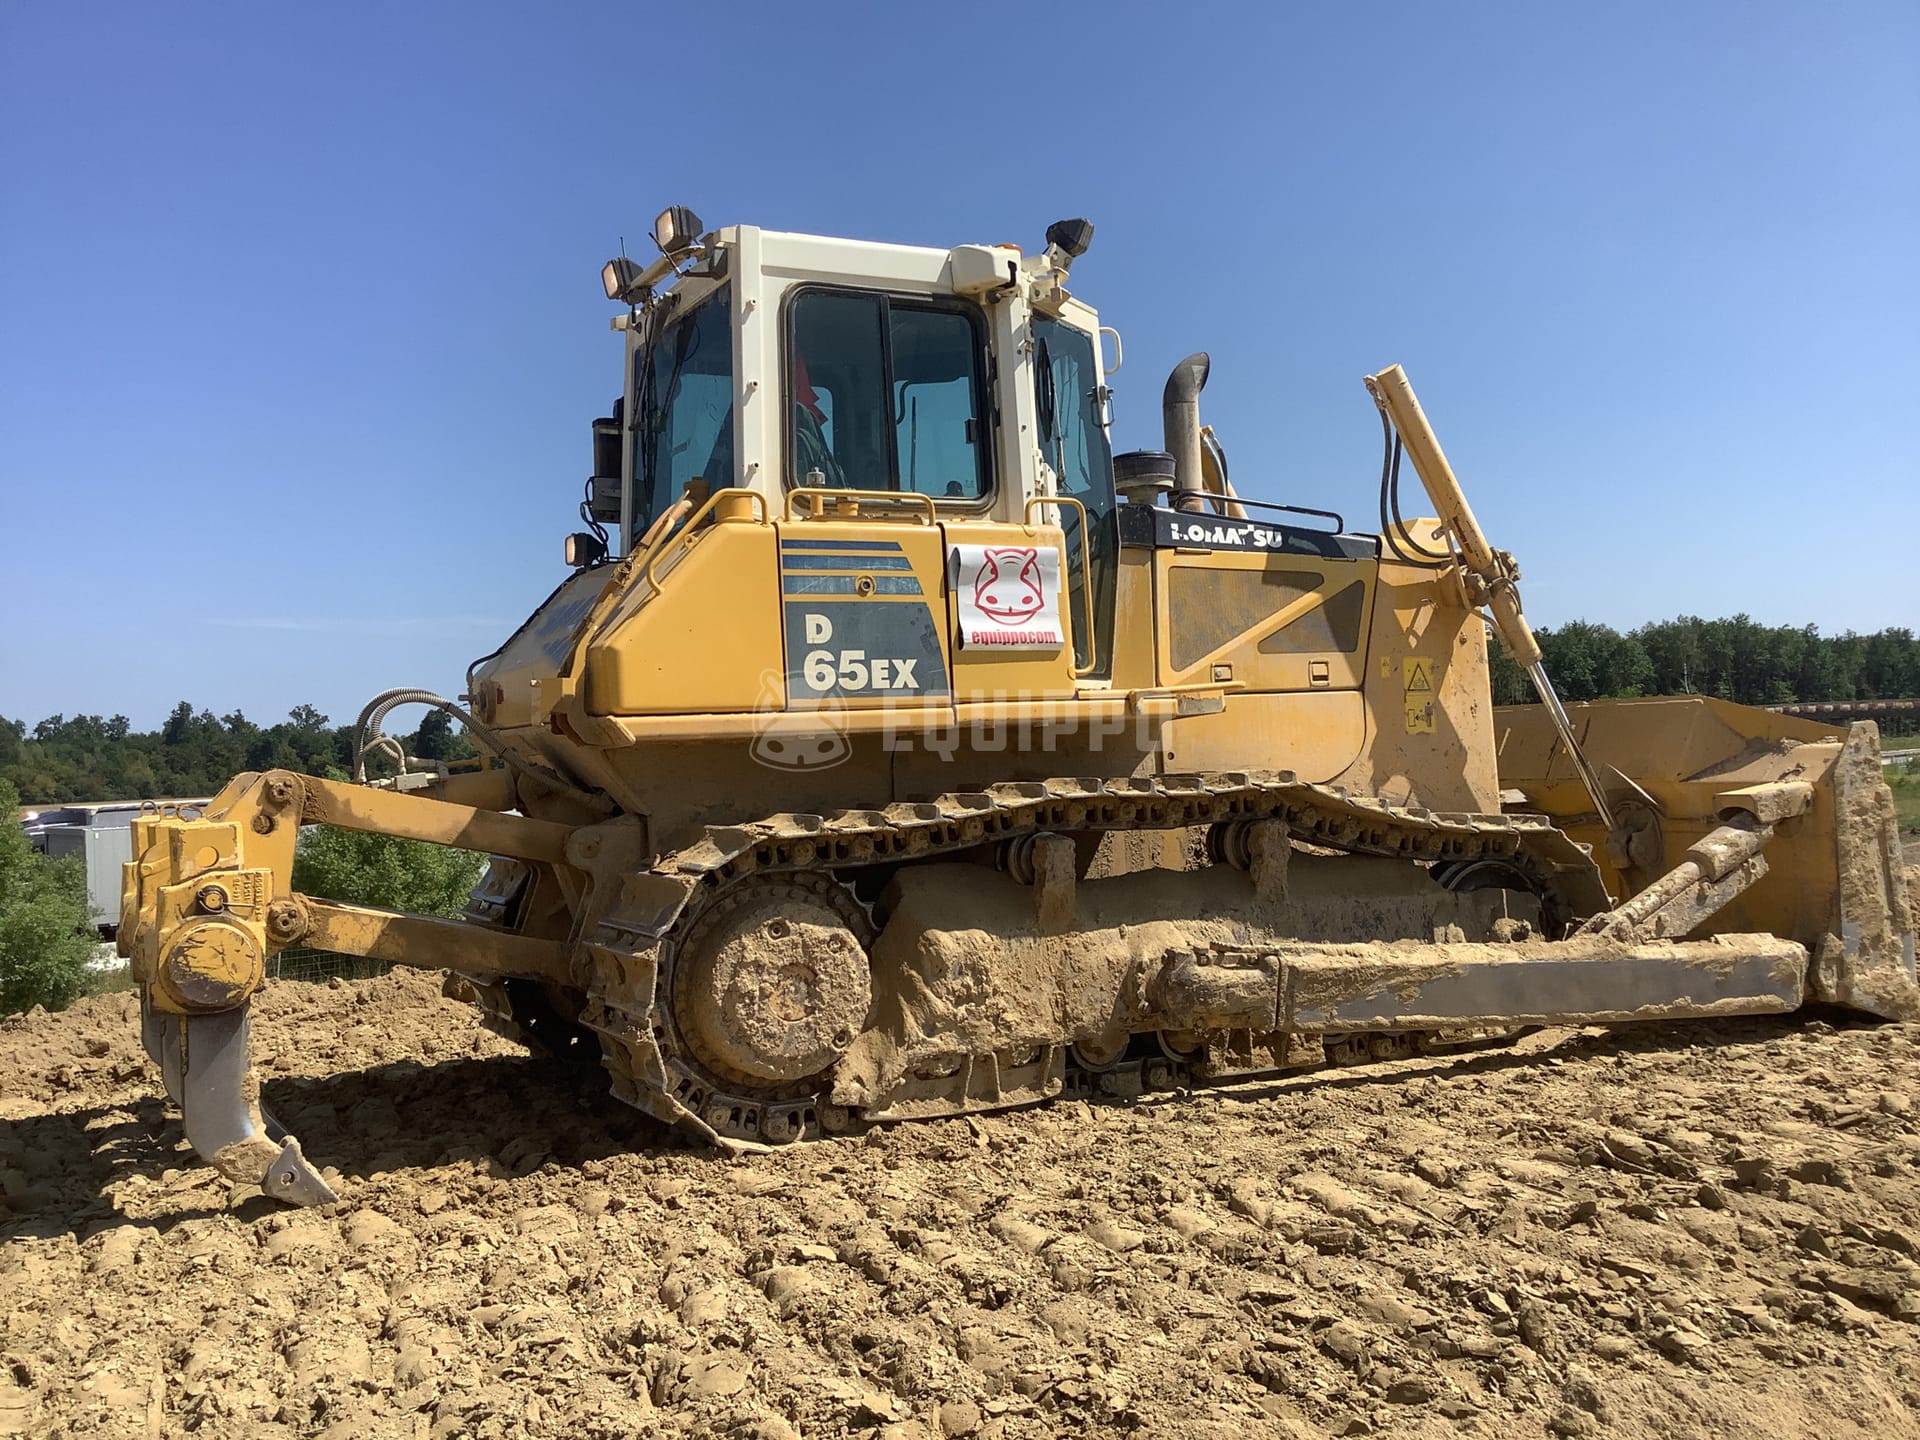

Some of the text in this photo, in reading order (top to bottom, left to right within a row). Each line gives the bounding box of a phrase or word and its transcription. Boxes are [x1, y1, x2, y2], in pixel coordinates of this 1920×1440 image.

[805, 613, 833, 645] D
[971, 630, 1057, 646] equippo.com
[803, 650, 920, 691] 65EX
